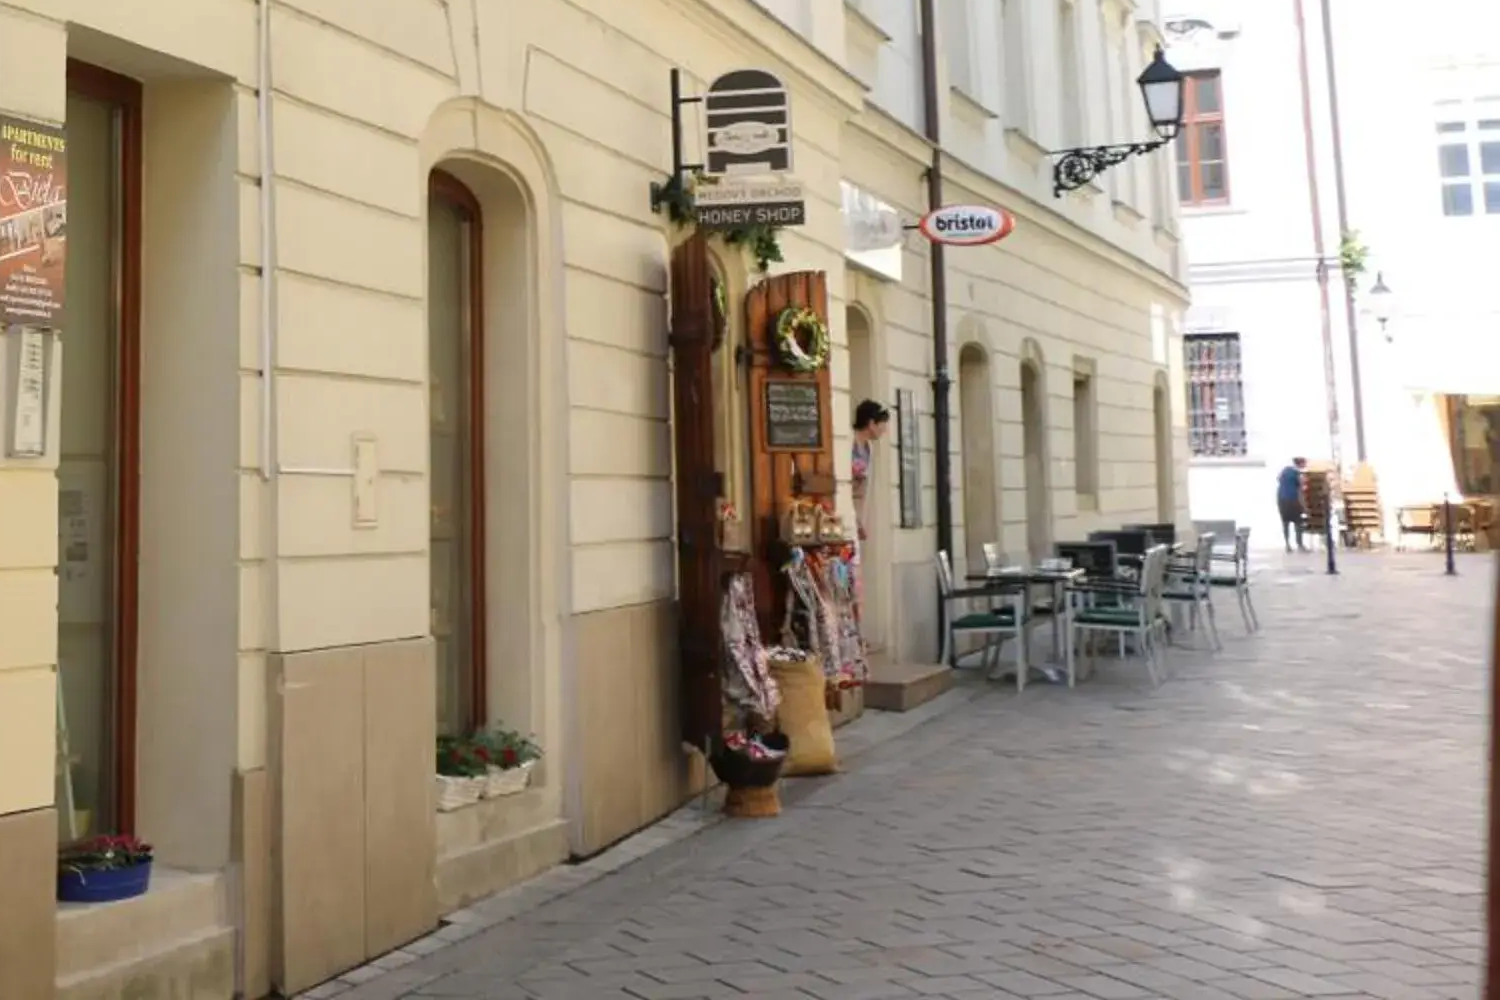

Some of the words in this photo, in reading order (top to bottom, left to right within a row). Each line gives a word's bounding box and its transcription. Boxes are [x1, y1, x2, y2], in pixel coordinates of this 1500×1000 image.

[11, 144, 29, 163] for
[29, 151, 53, 169] rent
[699, 208, 751, 224] HONEY
[755, 206, 800, 221] SHOP
[935, 213, 994, 231] bristol
